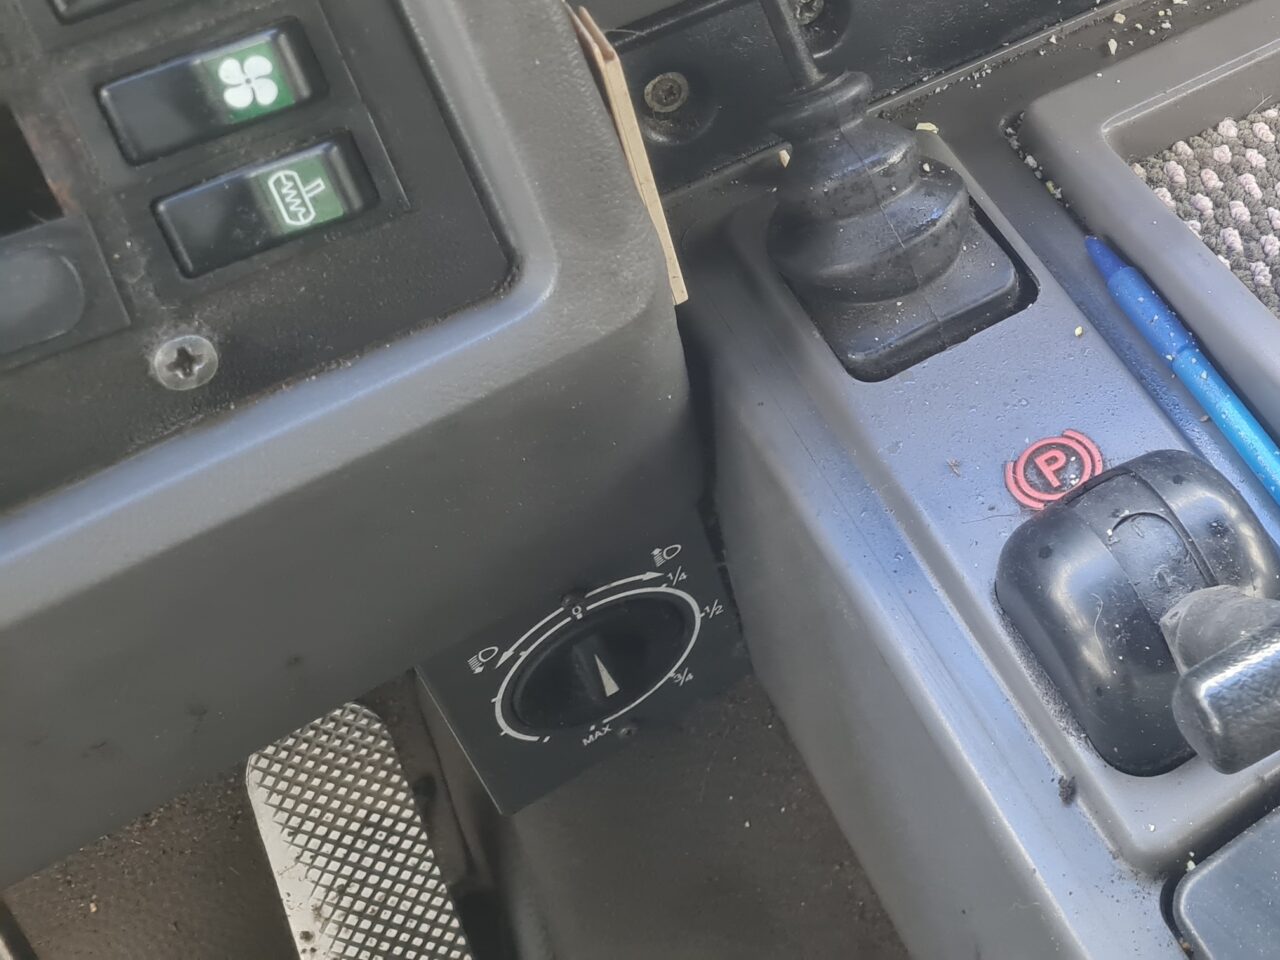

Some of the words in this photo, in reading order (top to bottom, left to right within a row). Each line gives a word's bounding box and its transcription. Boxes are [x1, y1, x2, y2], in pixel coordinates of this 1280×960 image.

[1034, 449, 1067, 488] P
[667, 565, 688, 586] 1/4
[704, 599, 724, 619] 1/2
[673, 667, 694, 687] 3/4
[582, 724, 612, 746] MAX
